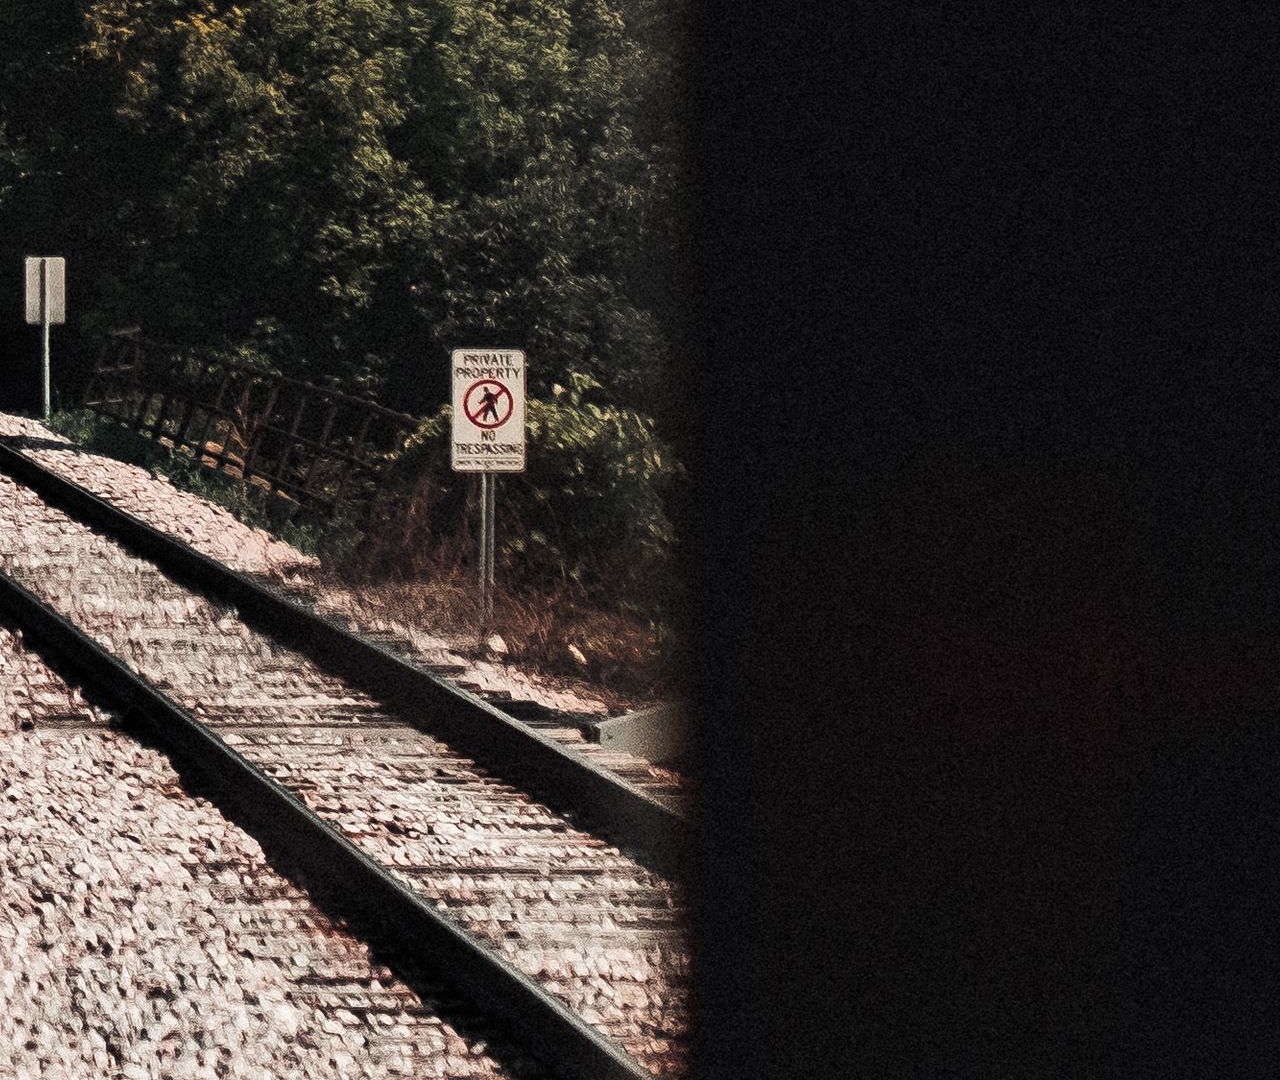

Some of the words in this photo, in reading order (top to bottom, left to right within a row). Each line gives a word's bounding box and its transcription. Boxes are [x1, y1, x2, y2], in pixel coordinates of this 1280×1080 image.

[463, 354, 513, 367] PRIVATE
[455, 368, 520, 379] PROPERTY
[481, 430, 496, 442] NO
[455, 443, 523, 455] TRESPASSING
